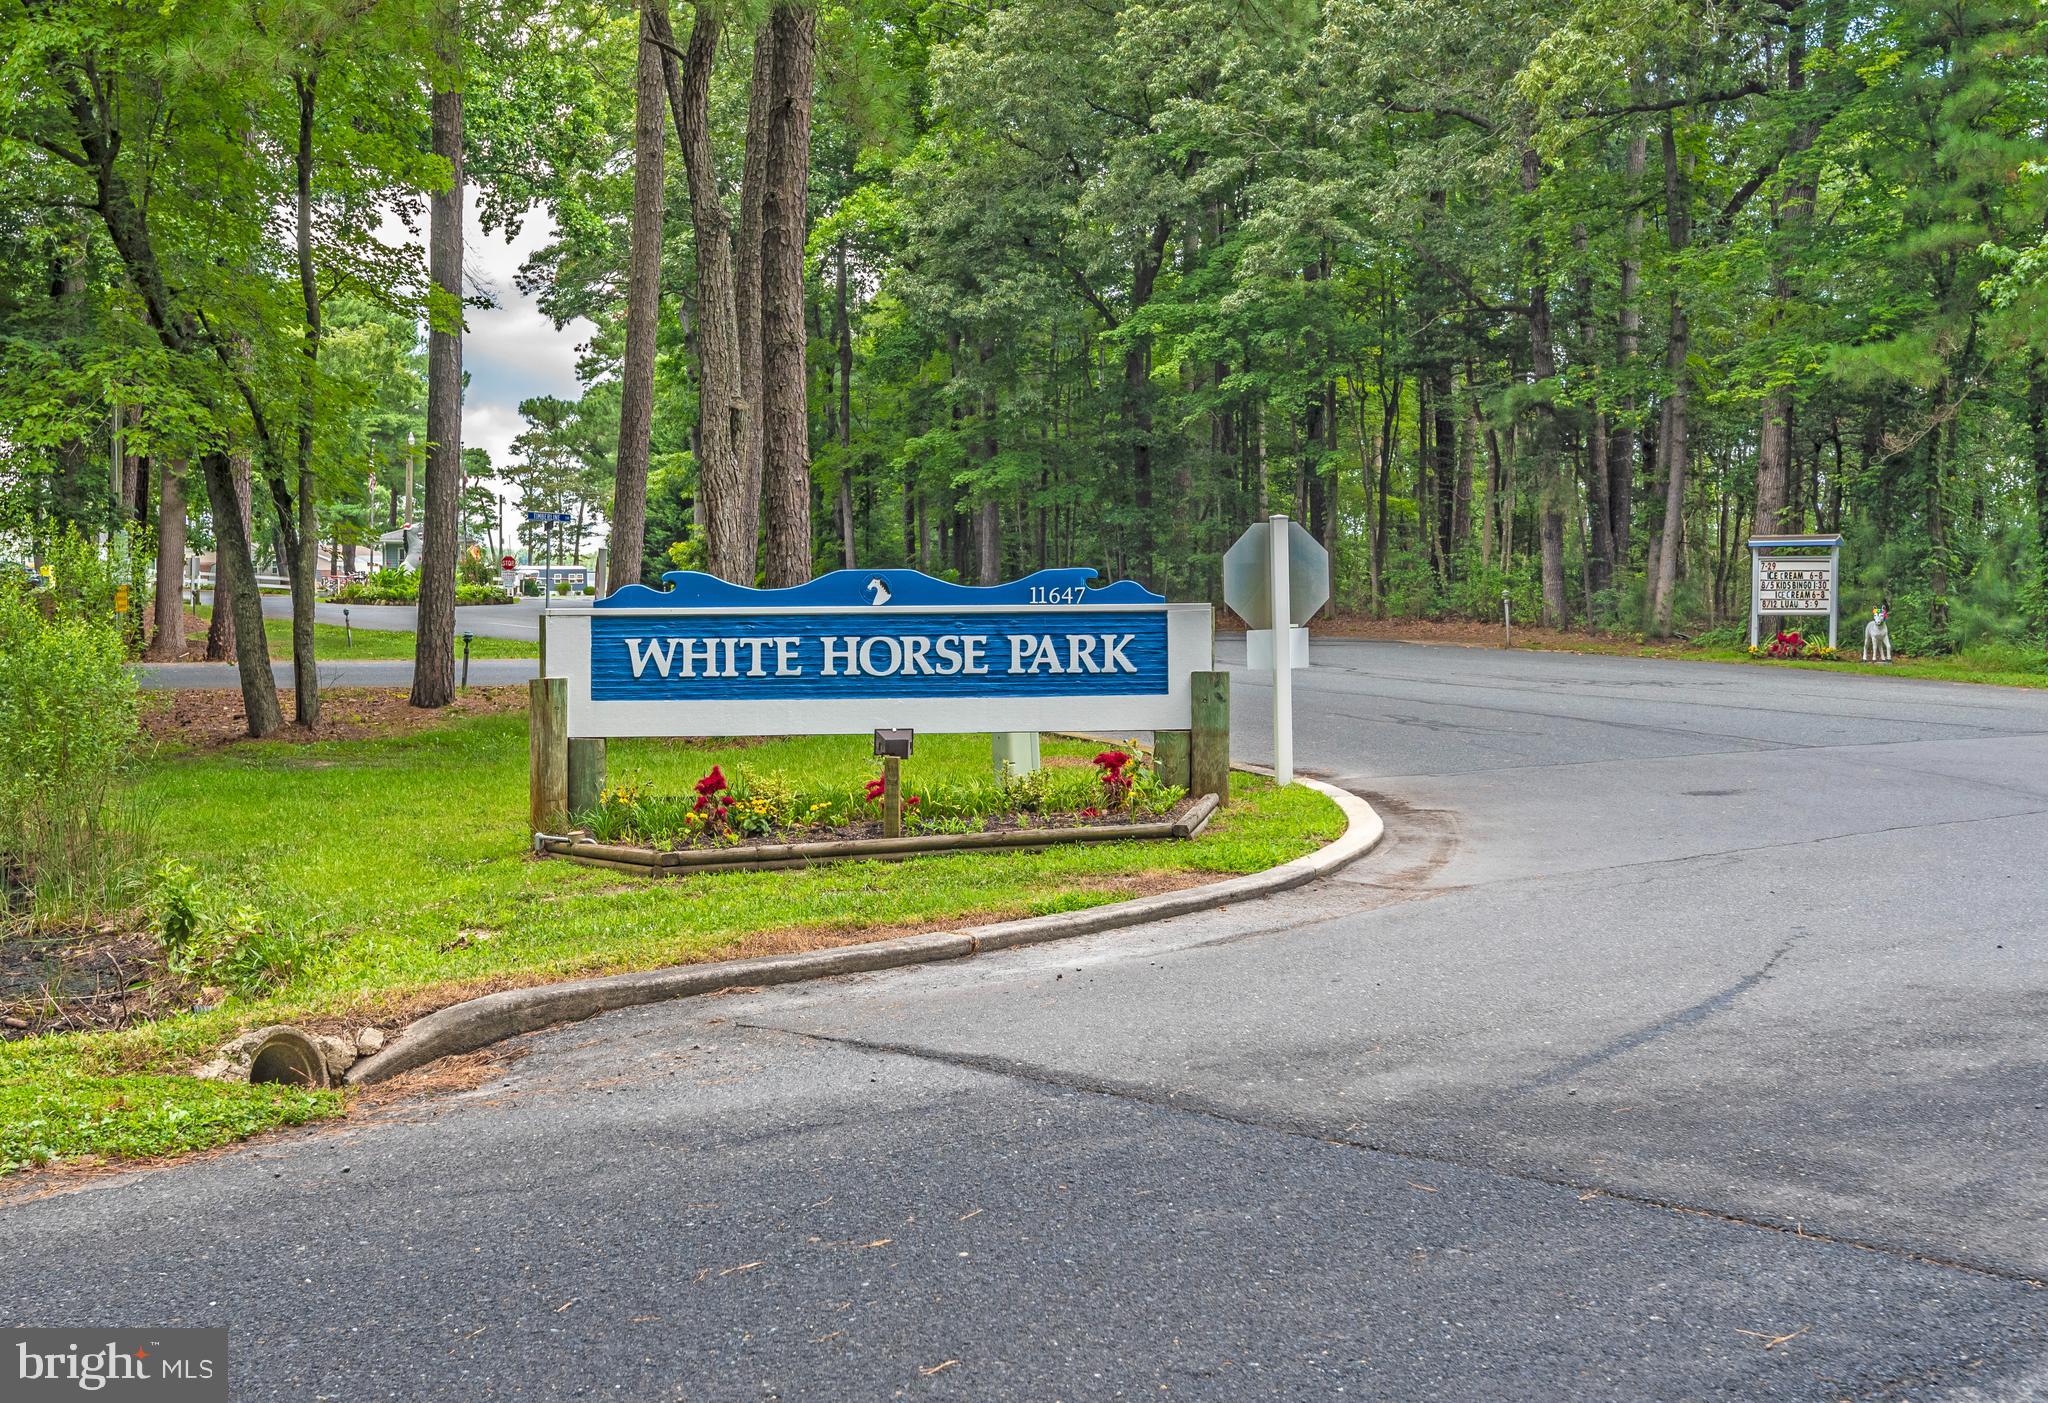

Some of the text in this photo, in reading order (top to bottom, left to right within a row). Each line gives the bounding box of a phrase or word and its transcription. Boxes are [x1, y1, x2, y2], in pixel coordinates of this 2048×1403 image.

[1761, 562, 1776, 570] 7-29
[1767, 572, 1823, 580] ICE CREAM 6-8
[1760, 581, 1827, 589] 8/5 KIDS BINGO 1:30
[1029, 585, 1087, 606] 11647
[1775, 591, 1825, 599] ICE CREAM 6-8
[1761, 600, 1777, 608] 8/12
[1780, 600, 1799, 608] LUAU
[624, 633, 1138, 679] WHITE HORSE PARK
